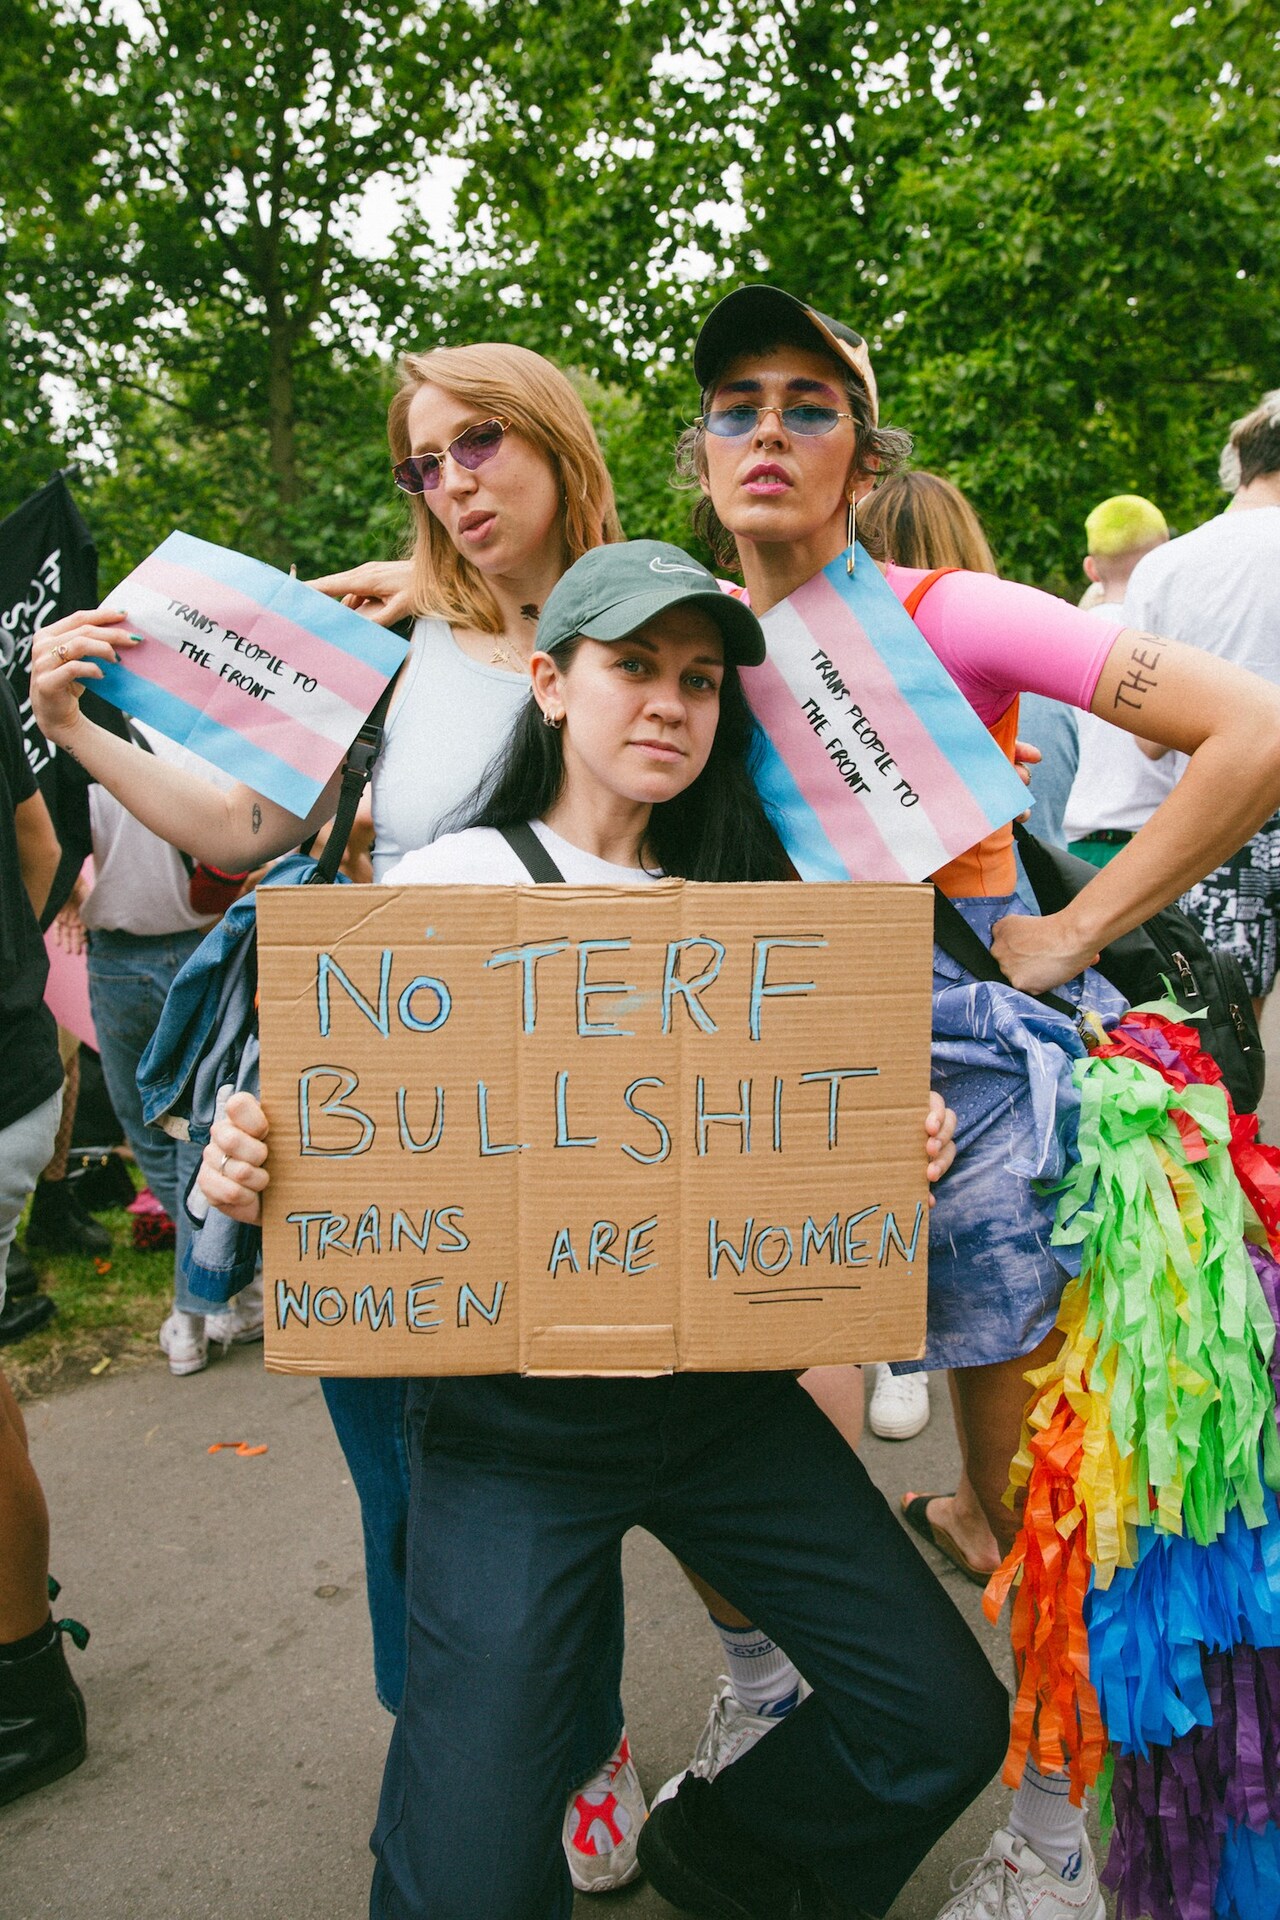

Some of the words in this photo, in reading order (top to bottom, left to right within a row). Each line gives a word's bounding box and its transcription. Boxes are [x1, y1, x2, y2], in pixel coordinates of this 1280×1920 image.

[166, 600, 219, 634] TRANS
[222, 629, 288, 676] PEOPLE
[292, 671, 318, 693] TO
[179, 640, 215, 669] THE
[219, 663, 275, 701] FRONT
[801, 697, 832, 737] THE
[825, 737, 872, 794] FRONT
[810, 649, 851, 701] TRANS
[844, 704, 898, 777] PEOPLE
[893, 778, 919, 807] TO
[483, 933, 828, 1042] TERF
[298, 1064, 881, 1165] BULLSHIT
[286, 1204, 470, 1261] TRANS
[547, 1213, 661, 1278] ARE
[708, 1200, 924, 1280] WOMEN
[274, 1276, 508, 1334] WOMEN
